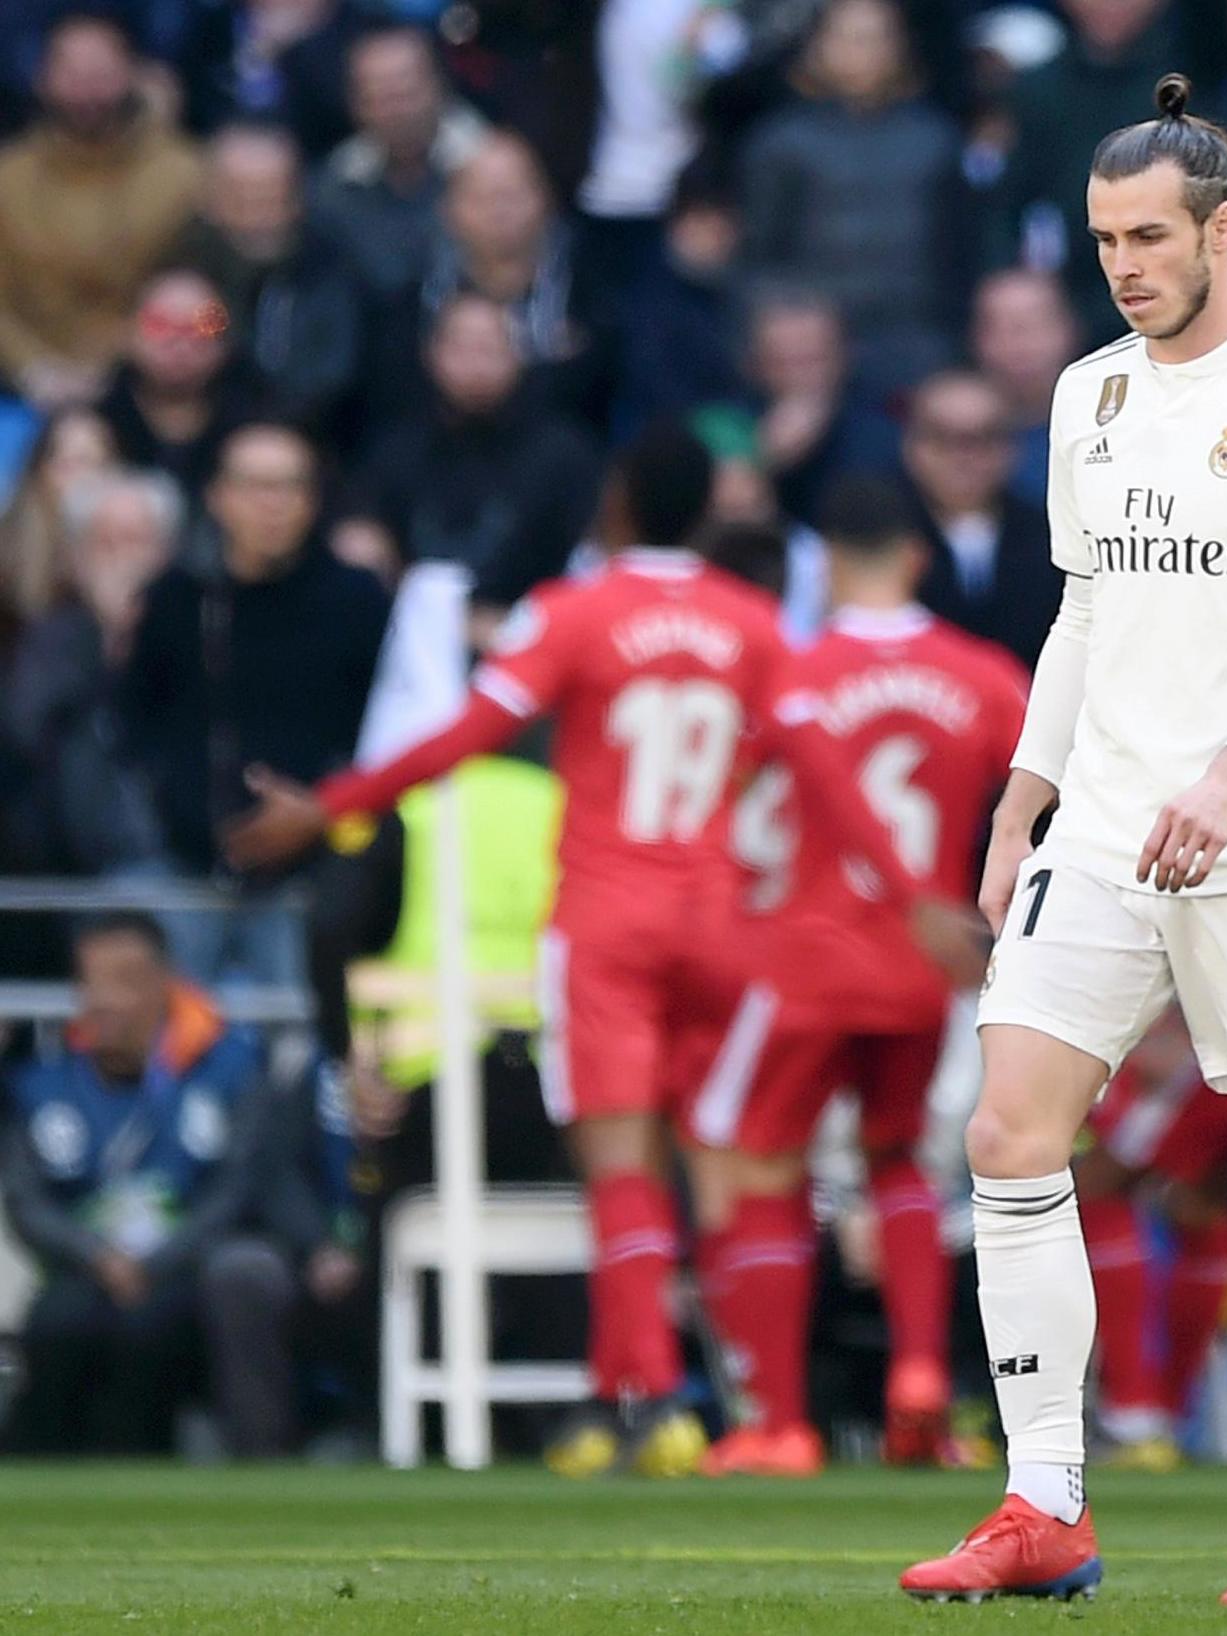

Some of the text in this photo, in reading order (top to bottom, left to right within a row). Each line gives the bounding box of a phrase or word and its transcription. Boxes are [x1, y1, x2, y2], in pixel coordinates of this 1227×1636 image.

[1125, 488, 1175, 527] Fly
[606, 680, 742, 843] 19
[1021, 868, 1053, 937] 1
[991, 1355, 1038, 1378] CF
